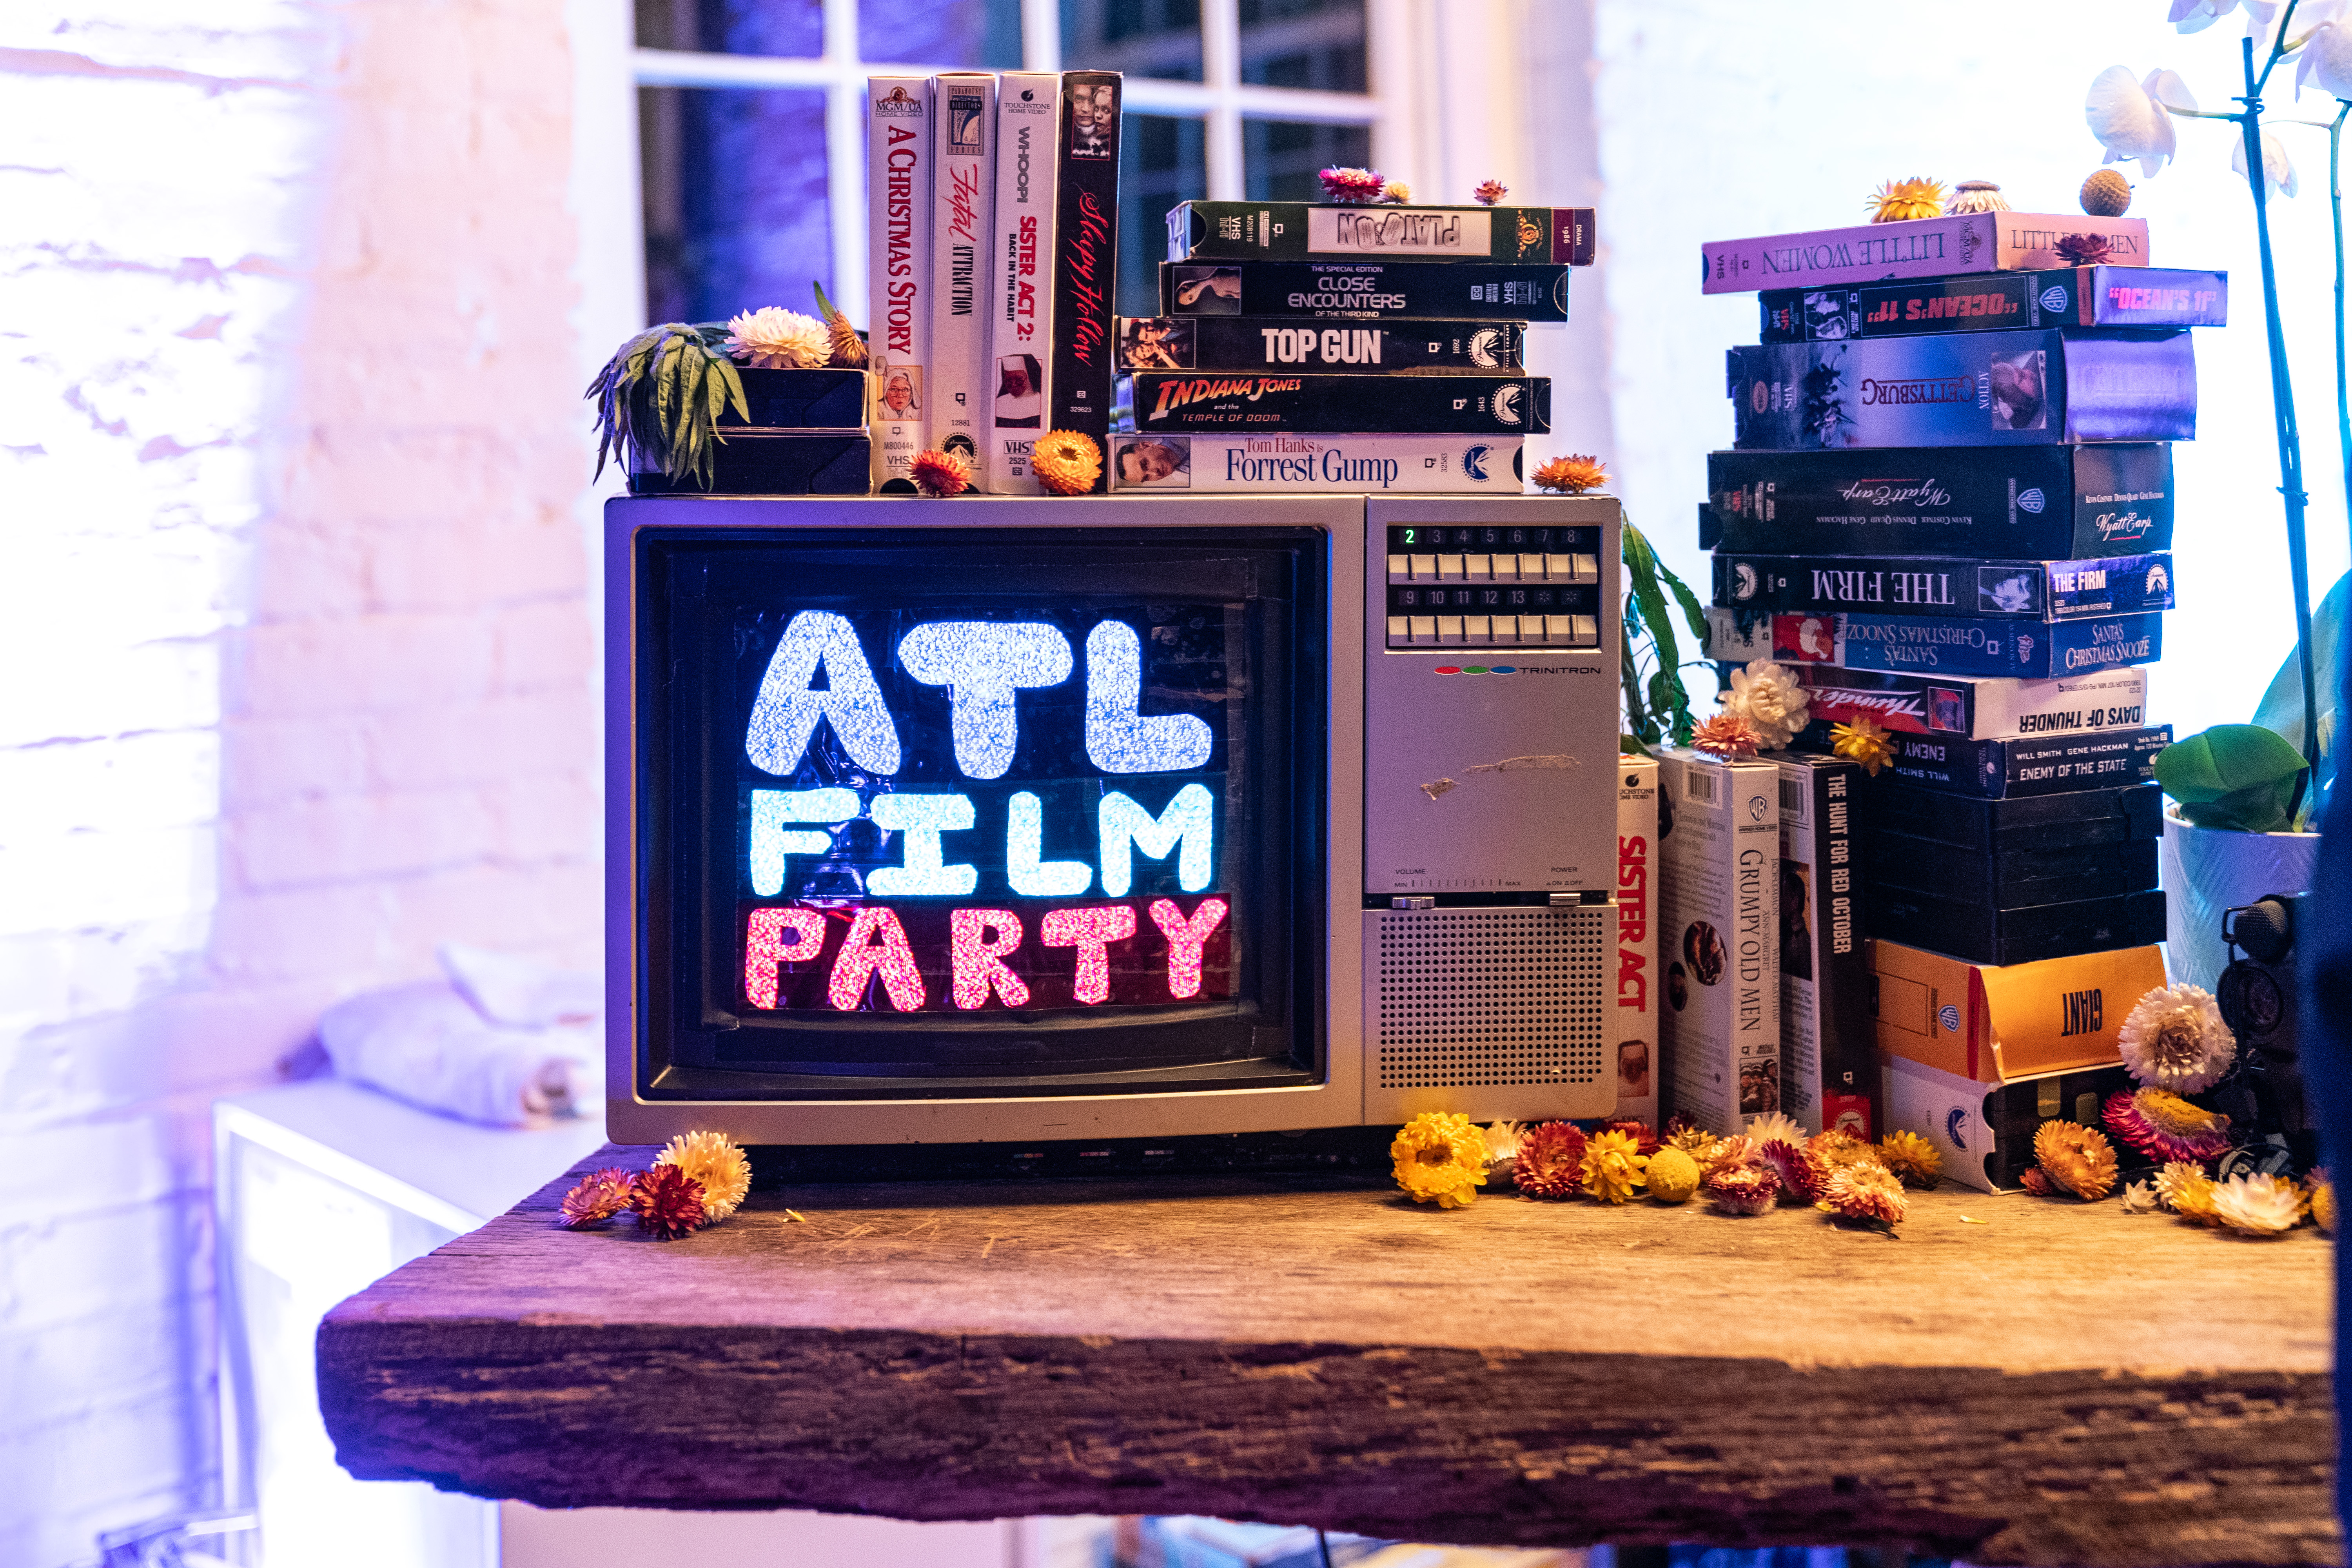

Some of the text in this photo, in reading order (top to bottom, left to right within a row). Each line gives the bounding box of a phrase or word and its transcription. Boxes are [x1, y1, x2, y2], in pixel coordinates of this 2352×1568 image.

[876, 103, 922, 111] MGM/UA
[1017, 127, 1030, 203] WHOOPI
[888, 125, 917, 354] A CHRISTMAS STORY
[942, 164, 978, 316] Fatal ATTRACTION
[1232, 216, 1241, 240] VHS
[1020, 216, 1036, 276] SISTER
[1763, 242, 1854, 275] WOMEN
[1858, 232, 1945, 265] LITTLE
[1009, 261, 1016, 270] IN
[1066, 182, 1109, 367] Sleepy Hollow
[1318, 277, 1375, 291] CLOSE
[1504, 282, 1513, 303] VHS
[1007, 294, 1015, 321] HABIT
[1018, 280, 1035, 318] ACT
[1288, 294, 1406, 309] ENCOUNTERS
[1261, 329, 1381, 363] TOP GUN
[1149, 378, 1301, 421] INDIANA JONES
[1861, 376, 1975, 405] GETTYSBURG
[1978, 371, 1990, 409] ACTION
[1005, 441, 1030, 453] VHS
[1245, 437, 1323, 453] Tom Hanks is
[887, 456, 910, 465] VHS
[1225, 449, 1398, 488] Forrest Gump
[1837, 479, 1951, 506] Wyatt Earp
[1405, 530, 1575, 543] 2 3 4 5 6 7 8
[2096, 512, 2154, 541] Wyatt Earp
[1811, 570, 1955, 604] THE FIRM
[2054, 570, 2106, 592] THE FIRM
[1406, 591, 1524, 604] 9 10 11 12 13
[1838, 625, 1985, 648] CHRISTMAS SNOOZ
[2092, 619, 2124, 645] SANTA'S
[1884, 646, 1938, 666] SANTA'S
[2065, 635, 2150, 669] CHRISTMAS SNOOZE
[746, 610, 1213, 780] ATL
[1814, 687, 1926, 717] Thunder
[2020, 706, 2140, 733] DAYS OF THUNDER
[1905, 742, 1945, 761] ENEMY
[2016, 752, 2035, 760] WILL
[2037, 750, 2061, 758] SMITH
[2091, 743, 2128, 752] HACKMAN
[1896, 766, 1950, 781] WILL SMITH
[2020, 766, 2054, 781] ENEMY
[2058, 765, 2071, 777] OF
[2075, 762, 2094, 775] THE
[2098, 759, 2127, 772] STATE
[751, 783, 1214, 898] FILM
[1828, 774, 1852, 954] THE HUNT FOR RED OCTOBER
[1618, 836, 1646, 1012] SISTER ACT
[1740, 850, 1763, 1031] GRUMPY OLD MEN
[744, 899, 1228, 1013] PARTY
[2060, 989, 2103, 1037] GIANT
